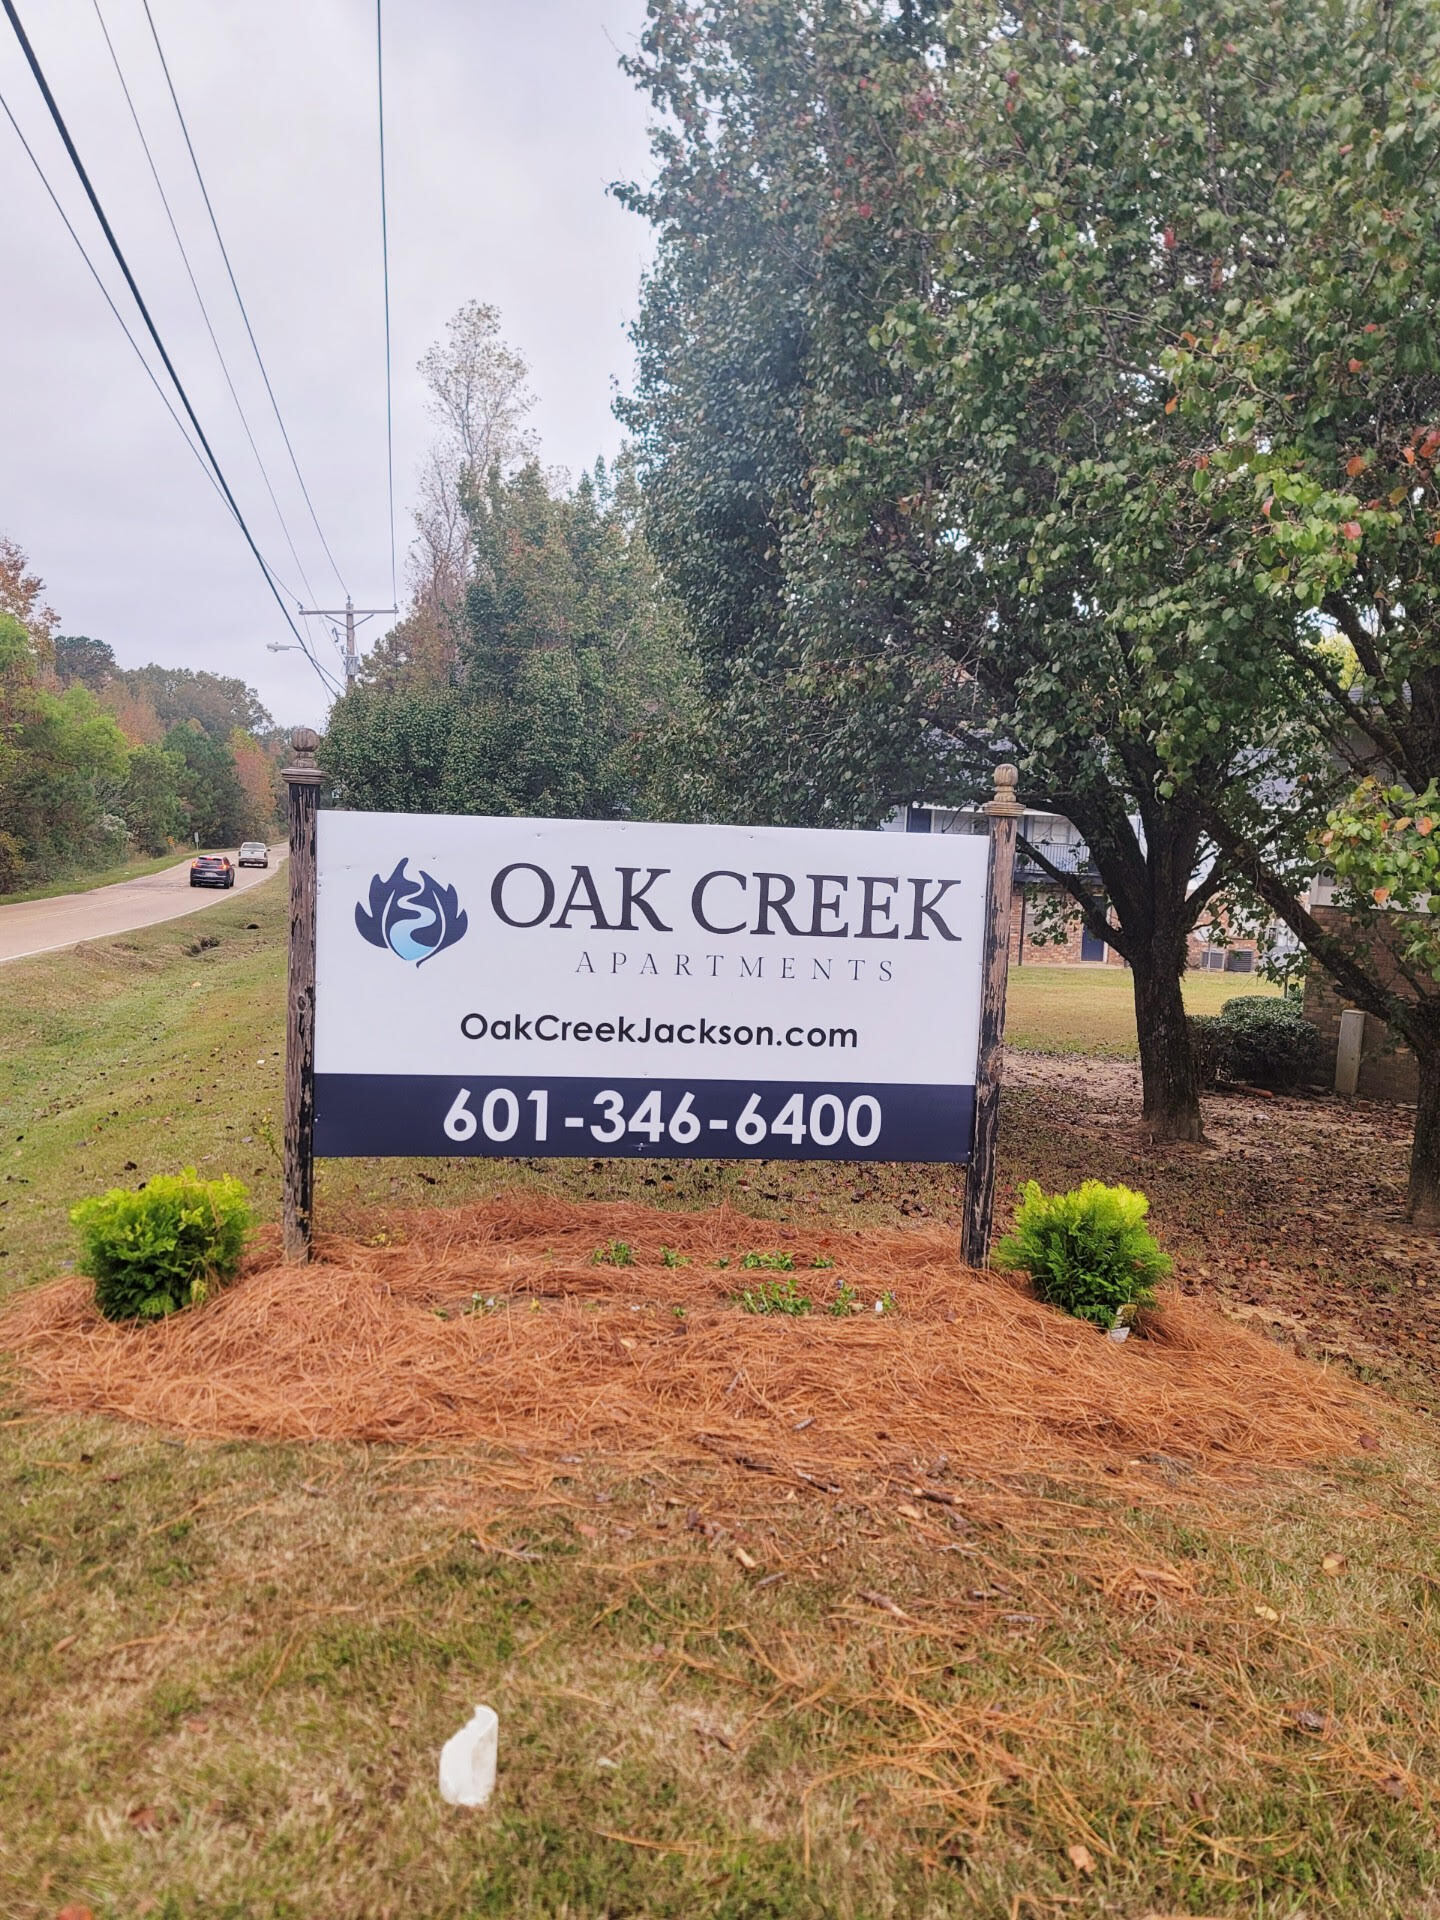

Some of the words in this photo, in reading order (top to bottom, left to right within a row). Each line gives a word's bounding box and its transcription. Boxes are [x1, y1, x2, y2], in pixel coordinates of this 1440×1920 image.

[491, 862, 673, 932] OAK
[692, 871, 963, 942] CREEK
[576, 951, 893, 982] APARTMENTS
[460, 1012, 858, 1048] OakCreekJackson.com
[443, 1088, 882, 1146] 601-346-6400
